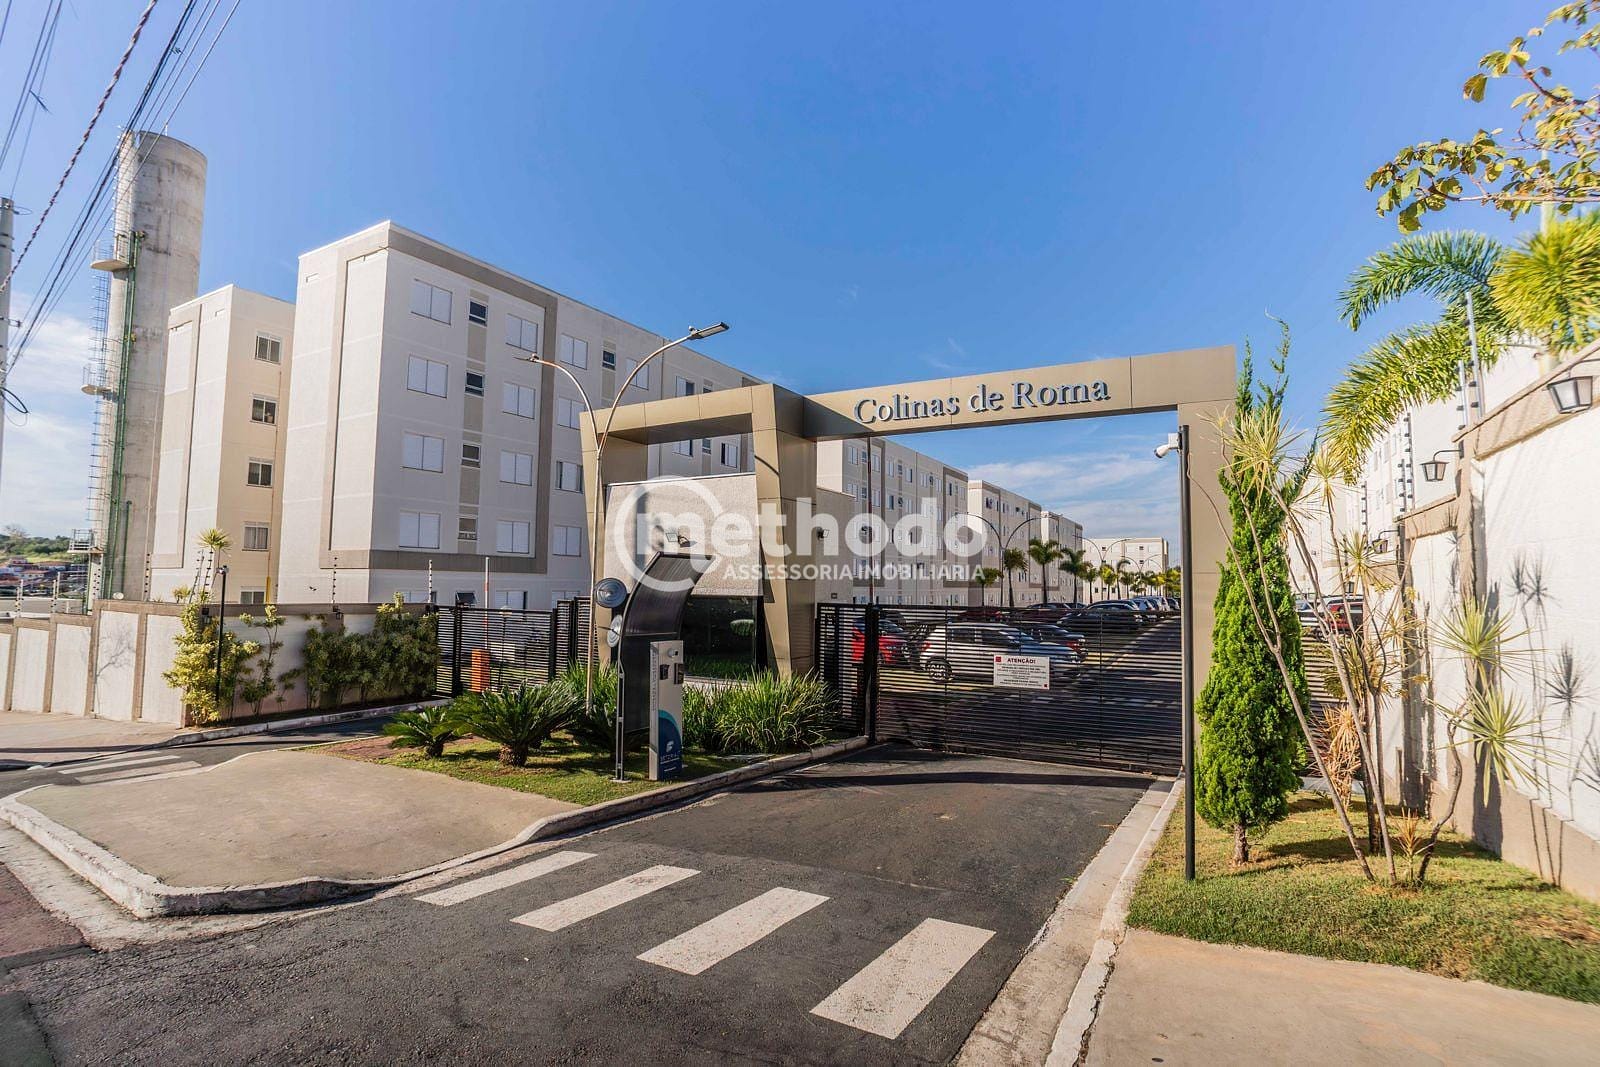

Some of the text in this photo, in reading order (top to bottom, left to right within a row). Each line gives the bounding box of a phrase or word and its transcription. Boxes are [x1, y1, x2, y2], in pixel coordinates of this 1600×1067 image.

[854, 380, 1112, 424] Colinas de Roma
